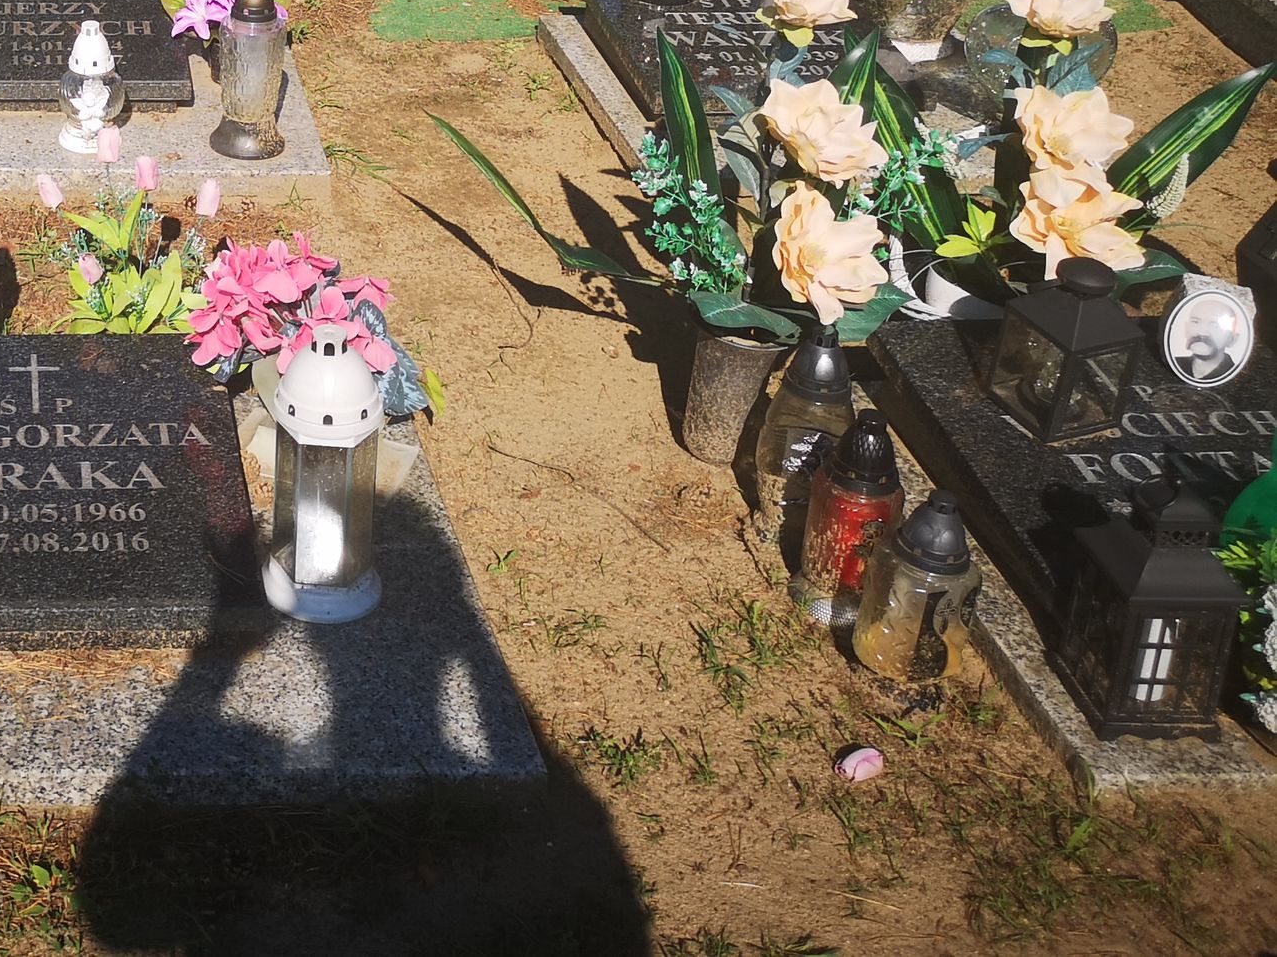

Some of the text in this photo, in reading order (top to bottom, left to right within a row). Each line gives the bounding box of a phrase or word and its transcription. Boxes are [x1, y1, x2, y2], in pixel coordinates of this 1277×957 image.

[665, 12, 763, 25] TERE
[1131, 385, 1155, 402] P
[0, 394, 73, 416] Ś P
